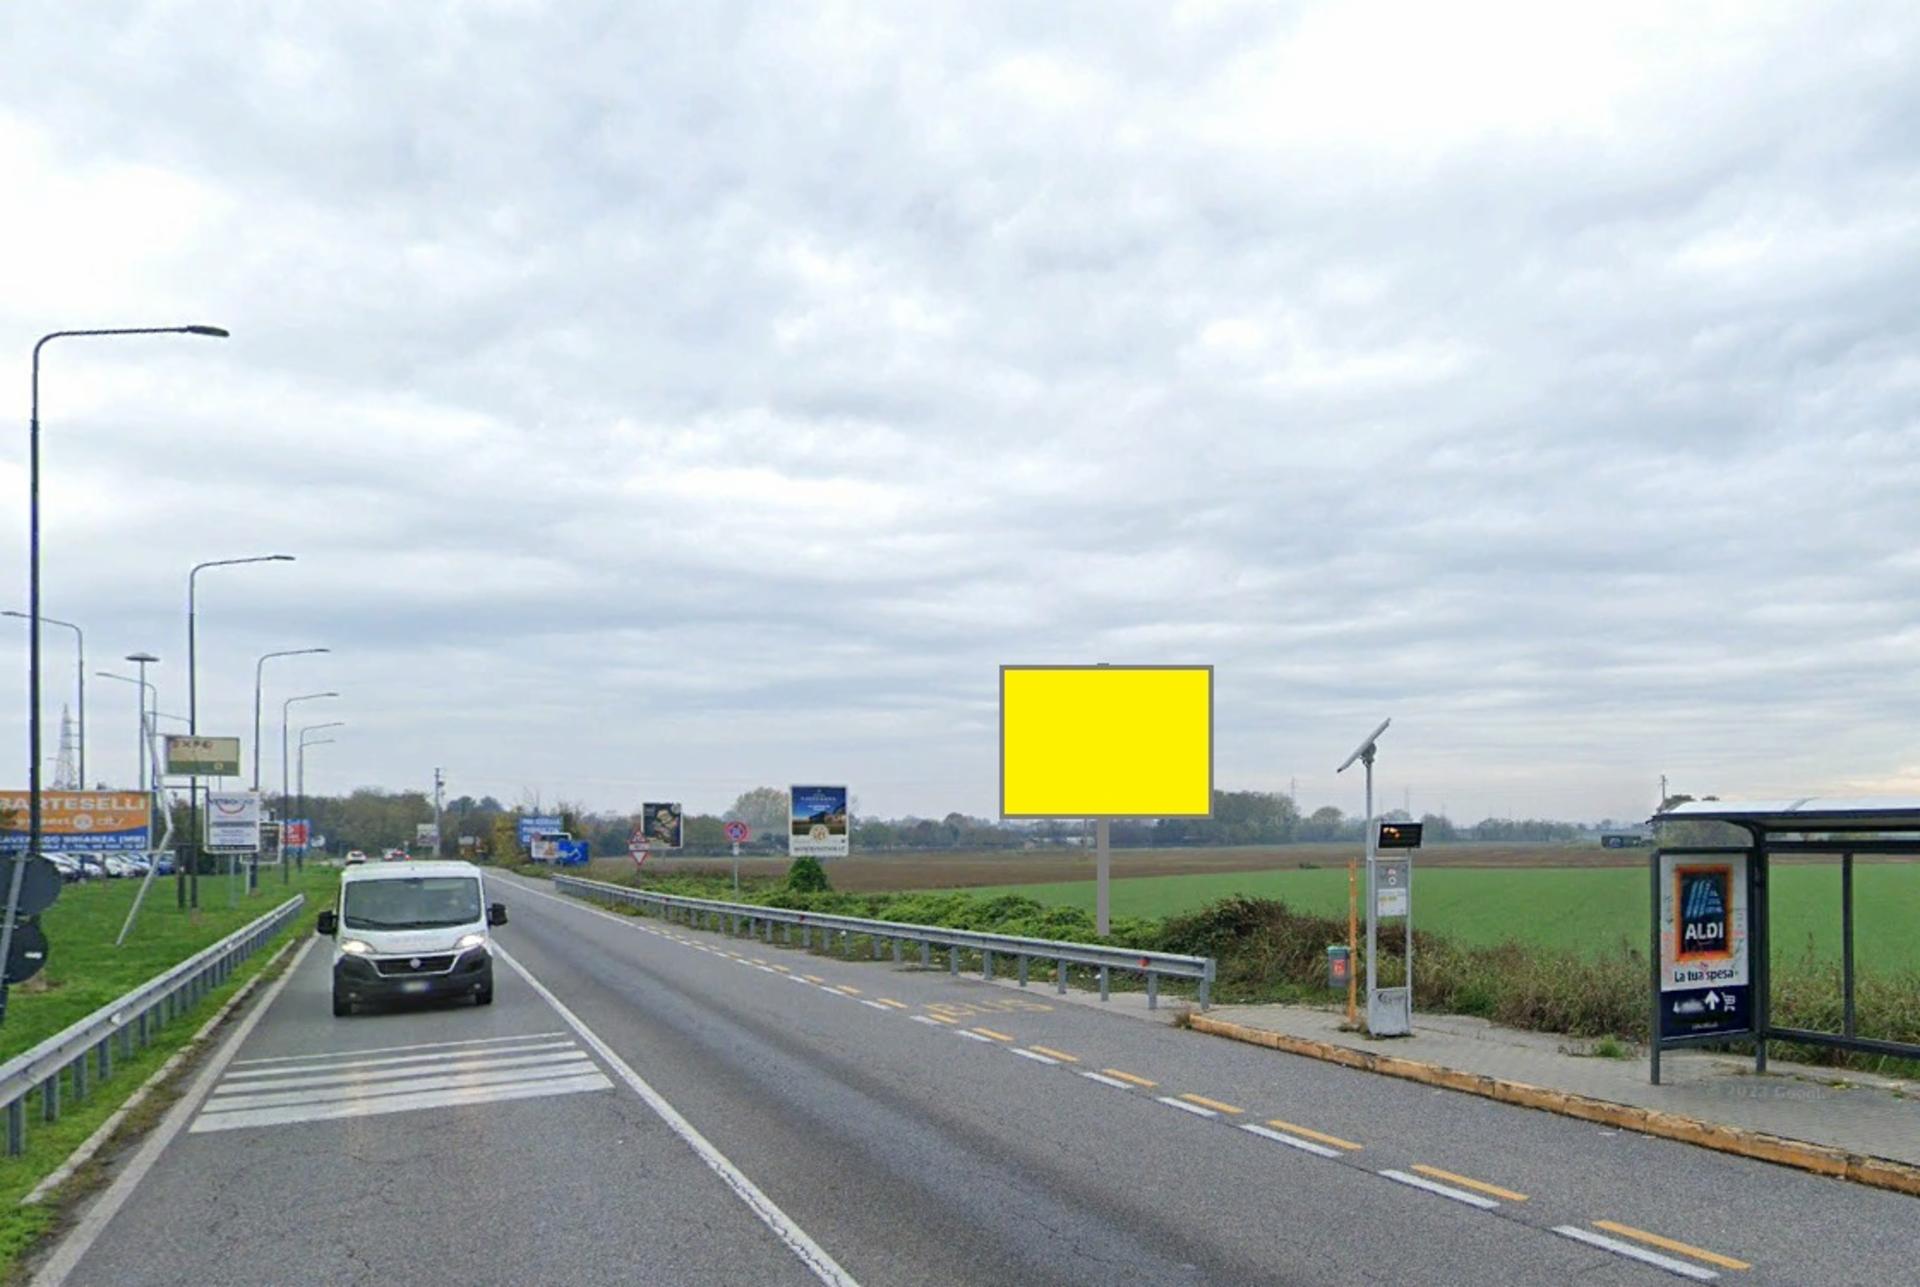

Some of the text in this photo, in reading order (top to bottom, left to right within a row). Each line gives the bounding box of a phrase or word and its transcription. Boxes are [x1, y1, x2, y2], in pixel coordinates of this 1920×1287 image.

[1685, 922, 1724, 941] ALDI
[1675, 969, 1734, 983] La tua spesa
